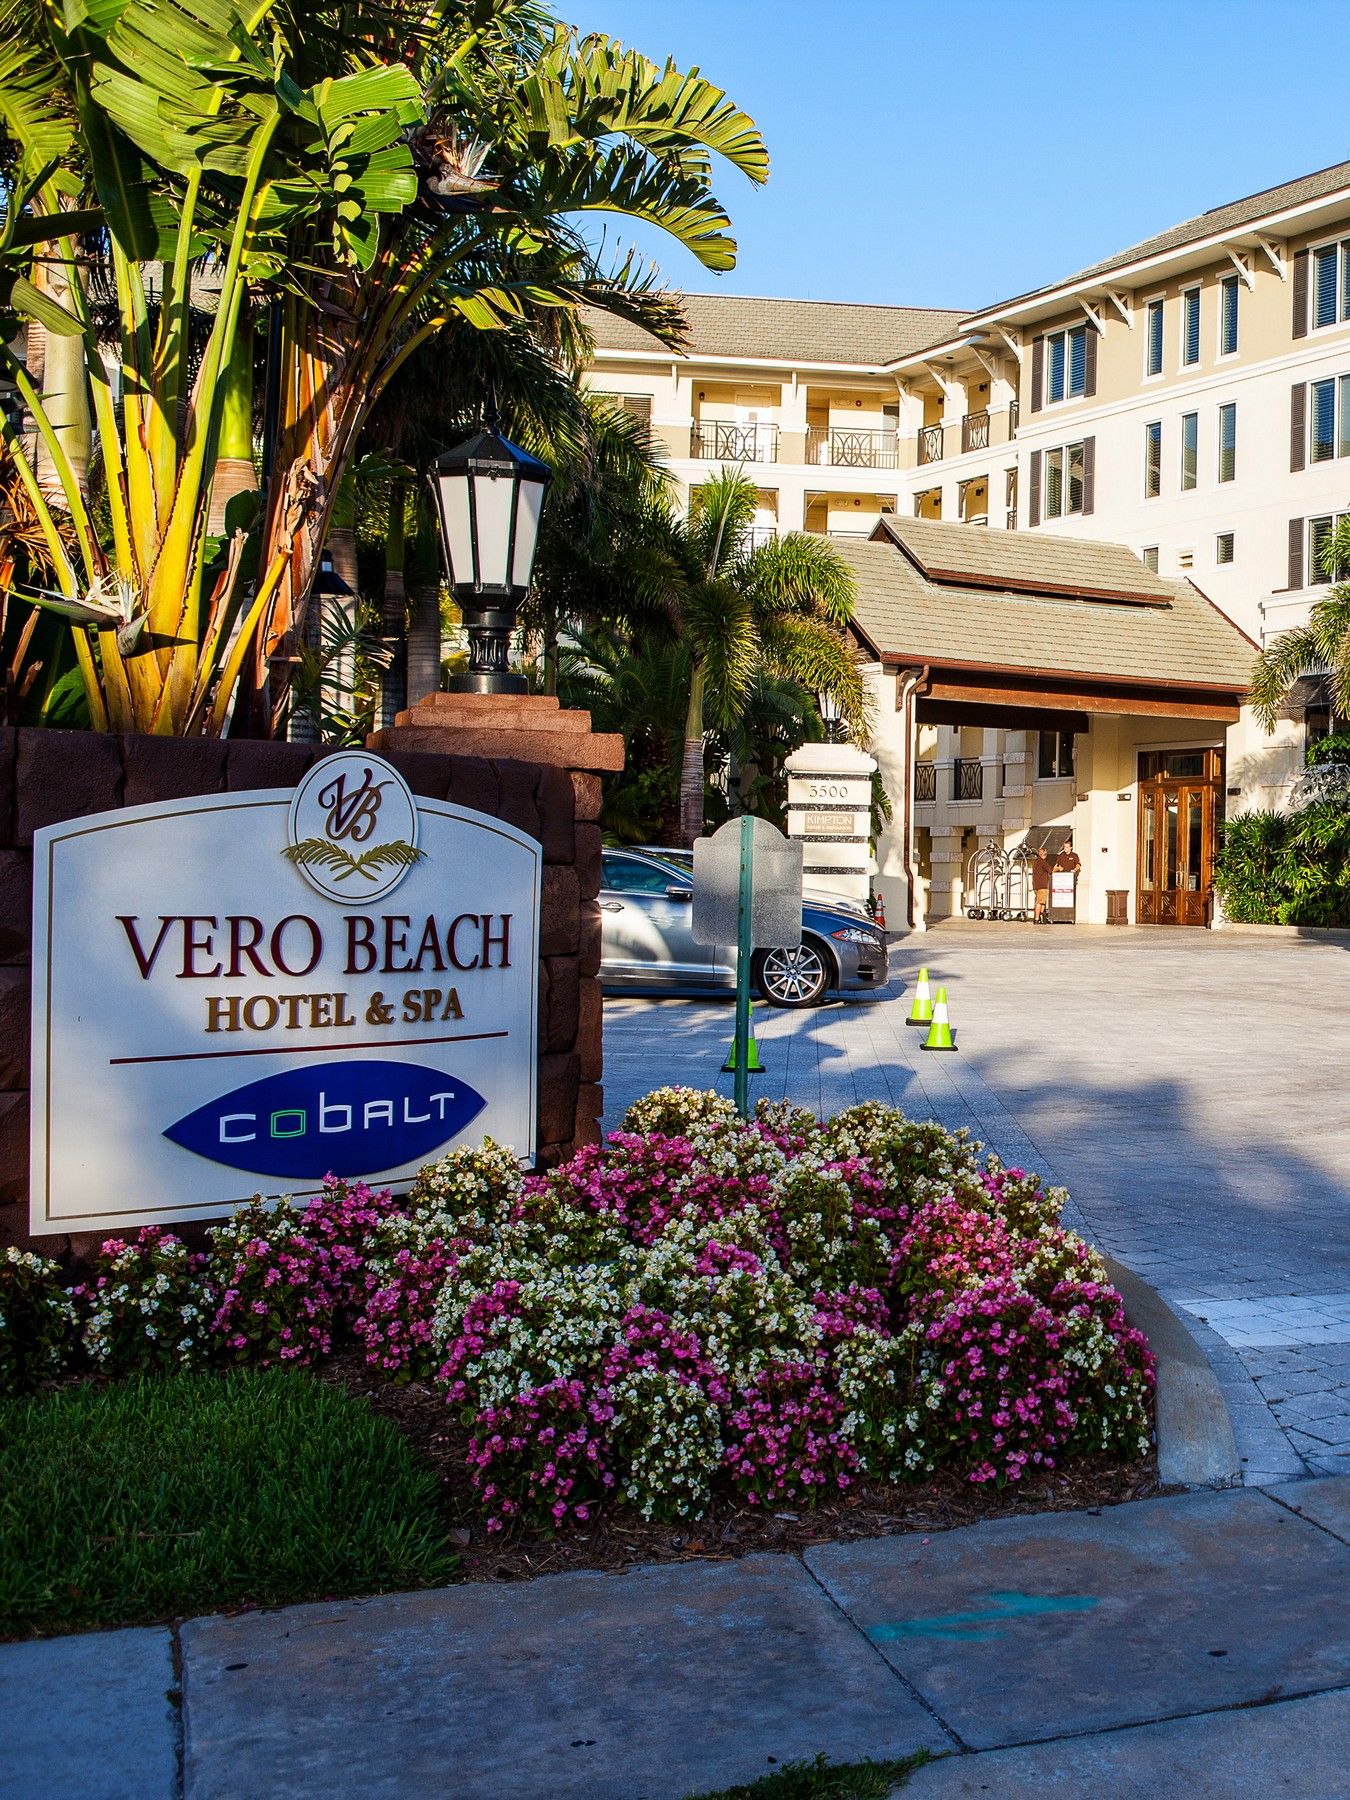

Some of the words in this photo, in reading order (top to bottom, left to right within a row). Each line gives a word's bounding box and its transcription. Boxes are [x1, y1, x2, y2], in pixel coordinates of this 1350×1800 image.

[318, 767, 395, 842] VB
[807, 815, 852, 825] KIMPTON
[115, 915, 324, 980] VERO
[343, 914, 514, 975] BEACH
[205, 992, 355, 1033] HOTEL
[365, 991, 395, 1025] &
[402, 987, 465, 1023] SPA
